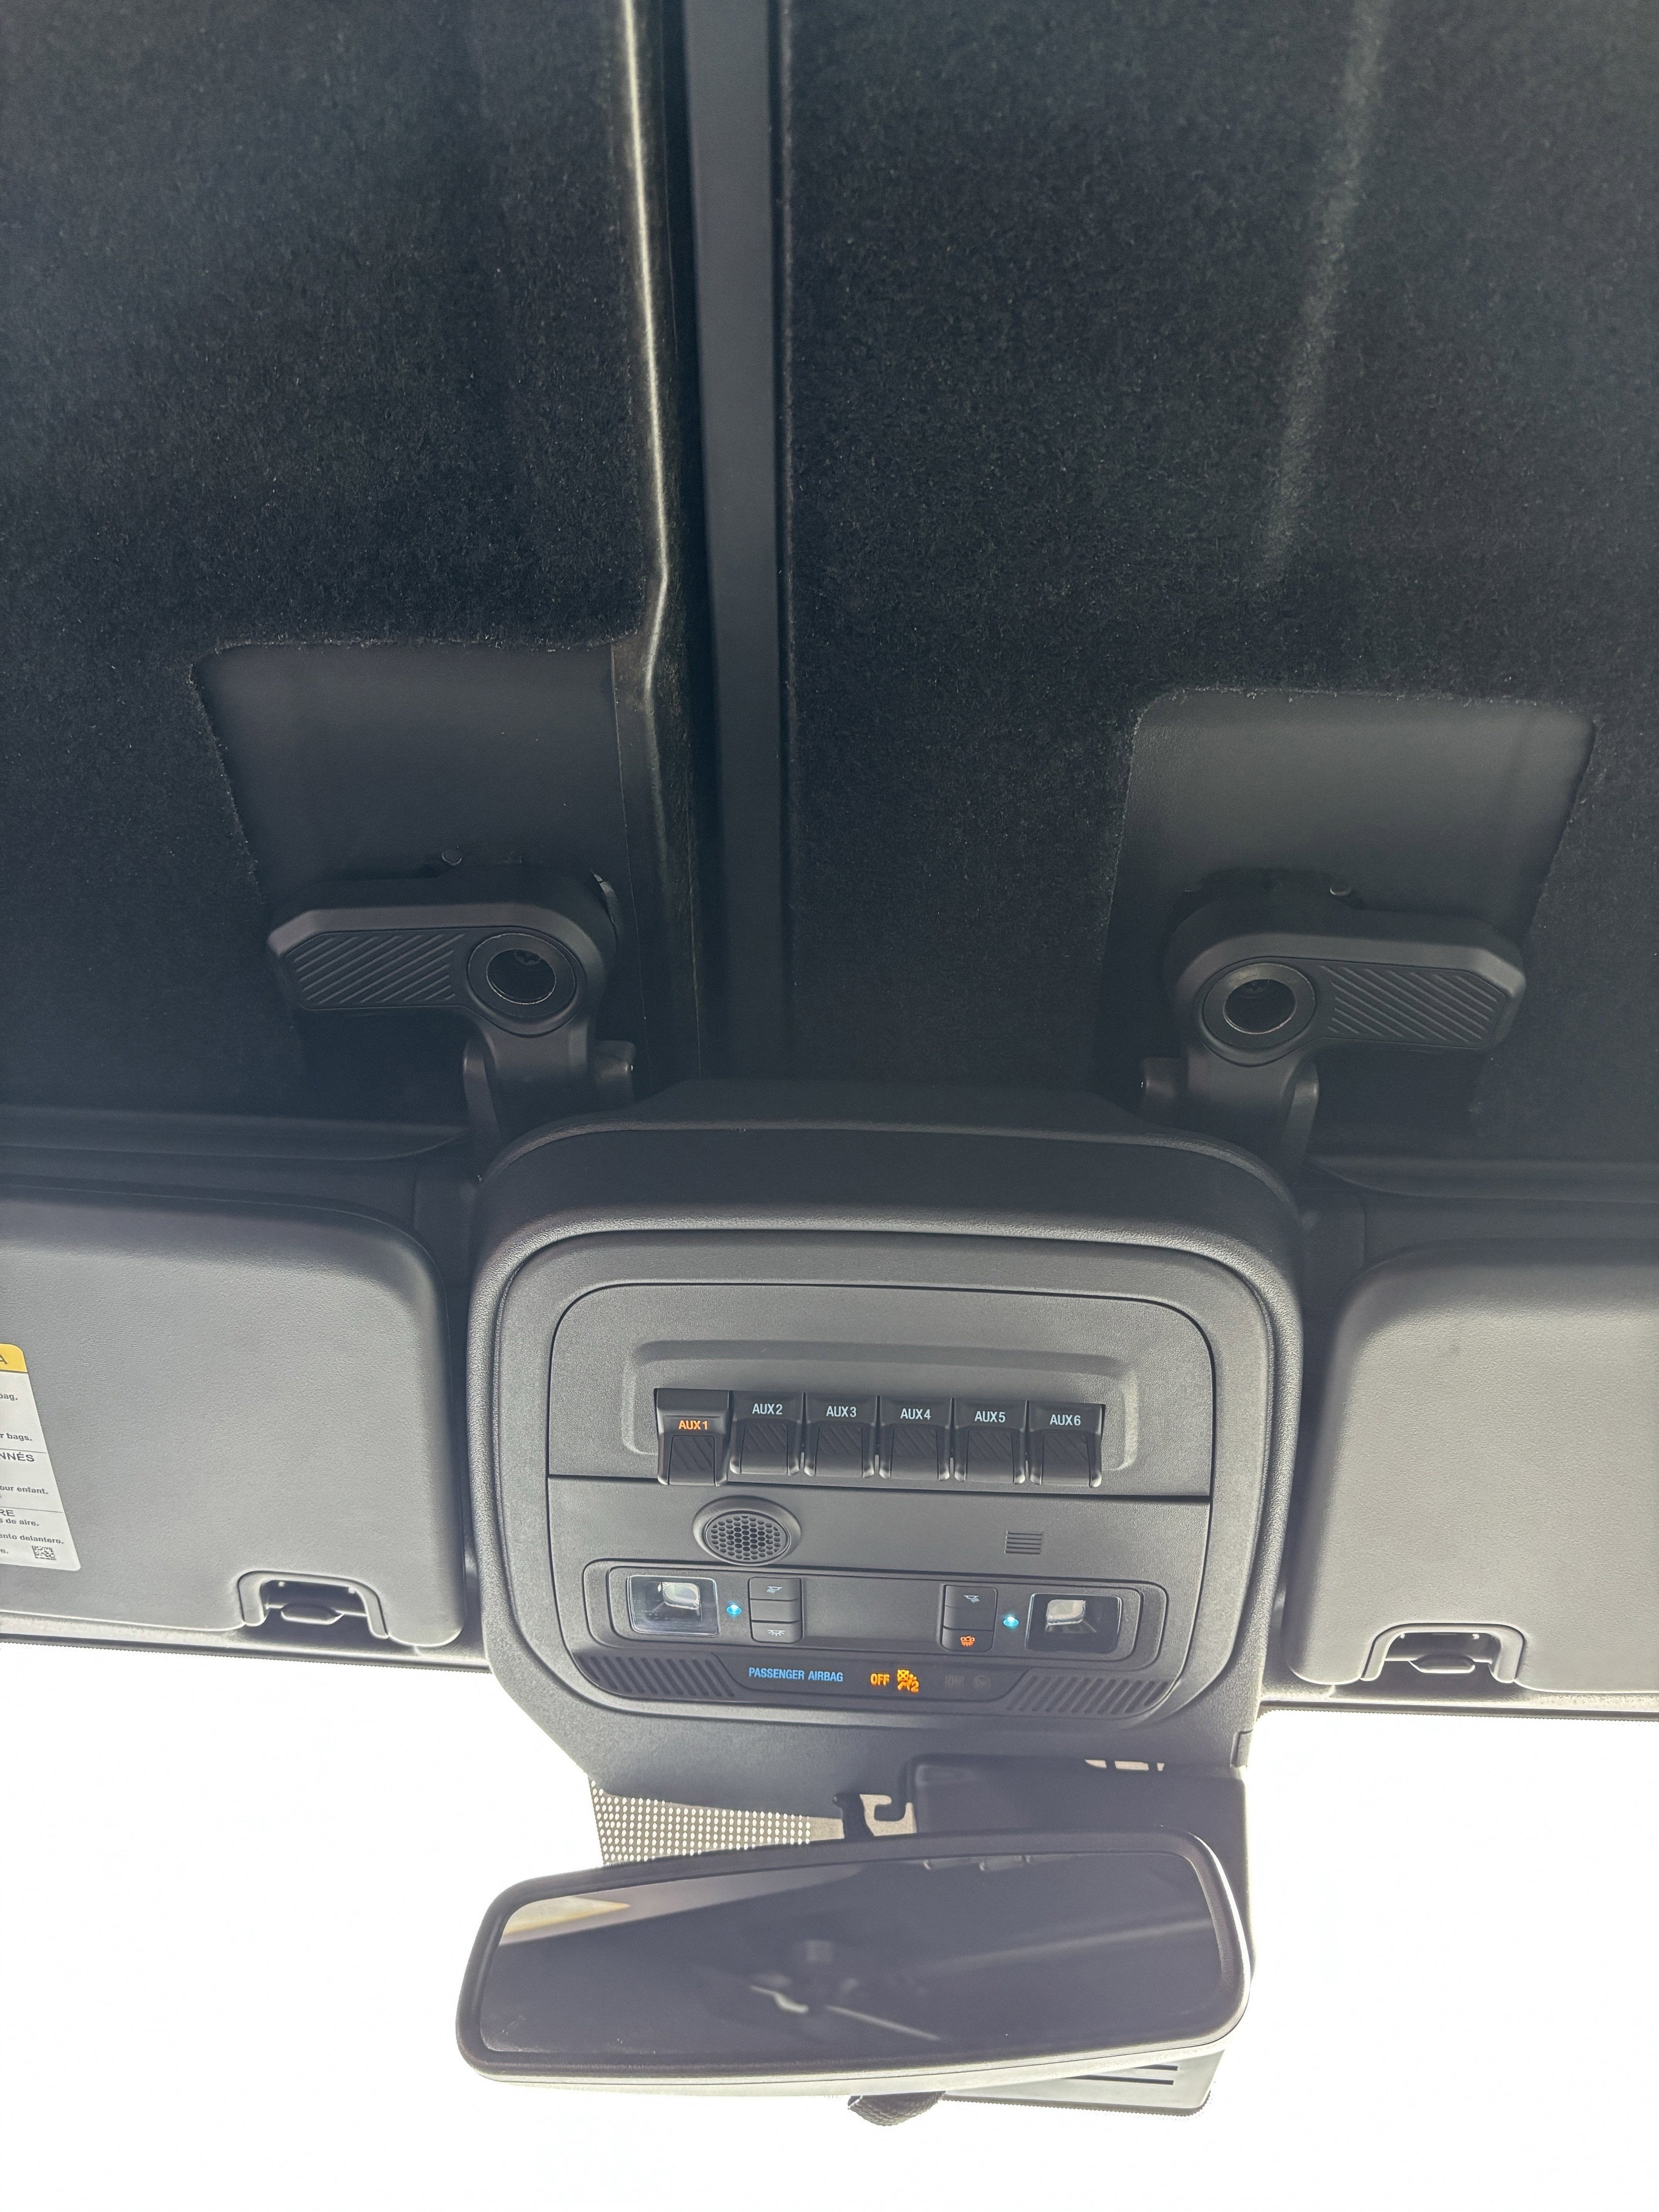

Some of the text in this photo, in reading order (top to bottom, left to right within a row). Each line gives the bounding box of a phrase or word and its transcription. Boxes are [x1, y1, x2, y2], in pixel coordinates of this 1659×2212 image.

[7, 1433, 32, 1441] bags.
[749, 1667, 890, 1686] PASSENGER AIRBAG OFF
